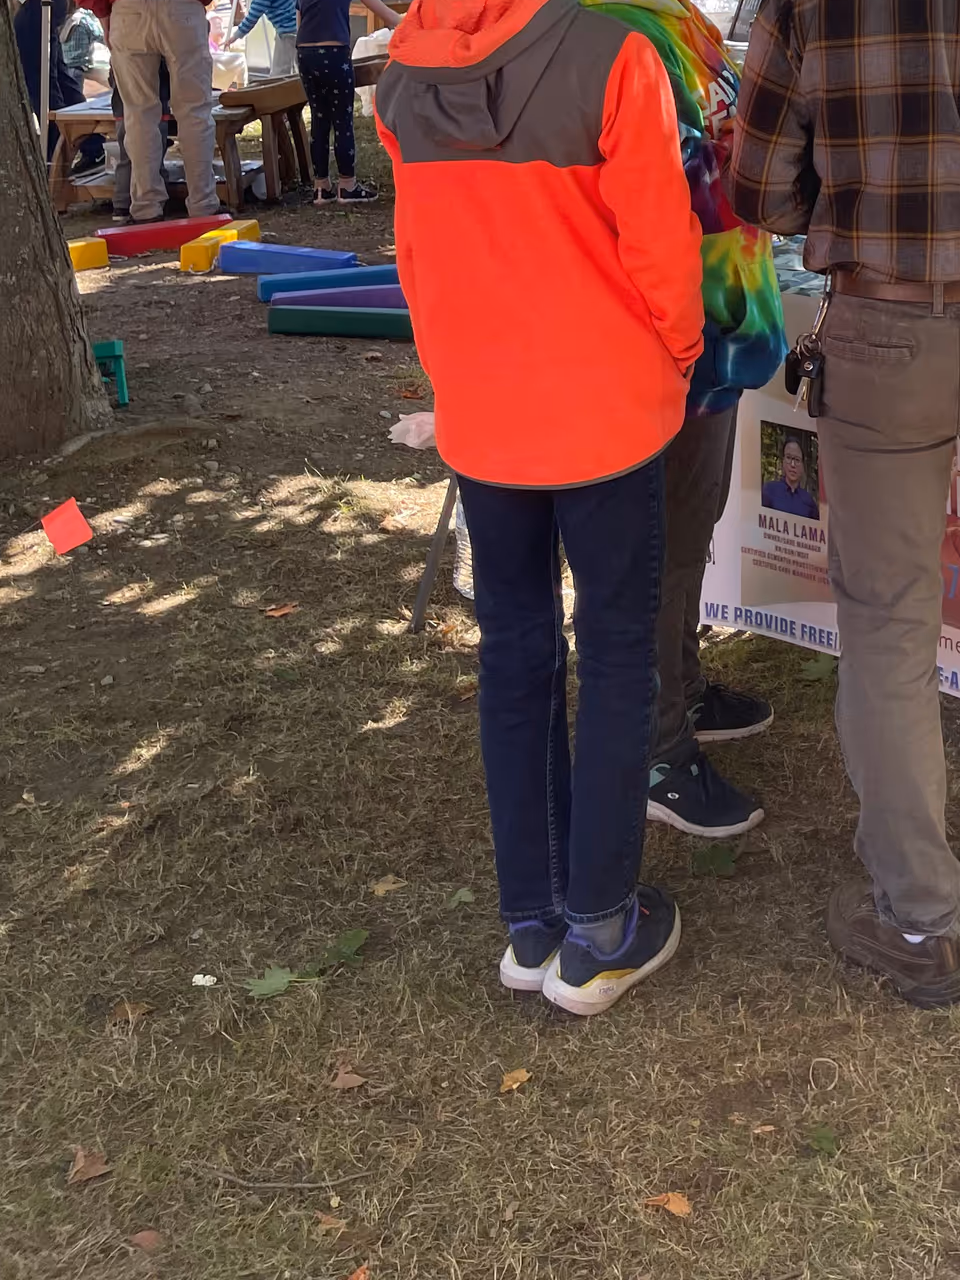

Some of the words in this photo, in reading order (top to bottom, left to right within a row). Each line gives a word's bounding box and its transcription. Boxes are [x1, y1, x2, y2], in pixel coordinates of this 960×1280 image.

[758, 513, 789, 535] MALA
[794, 523, 826, 545] LAMA
[705, 602, 728, 620] WE
[734, 607, 796, 637] PROVIDE
